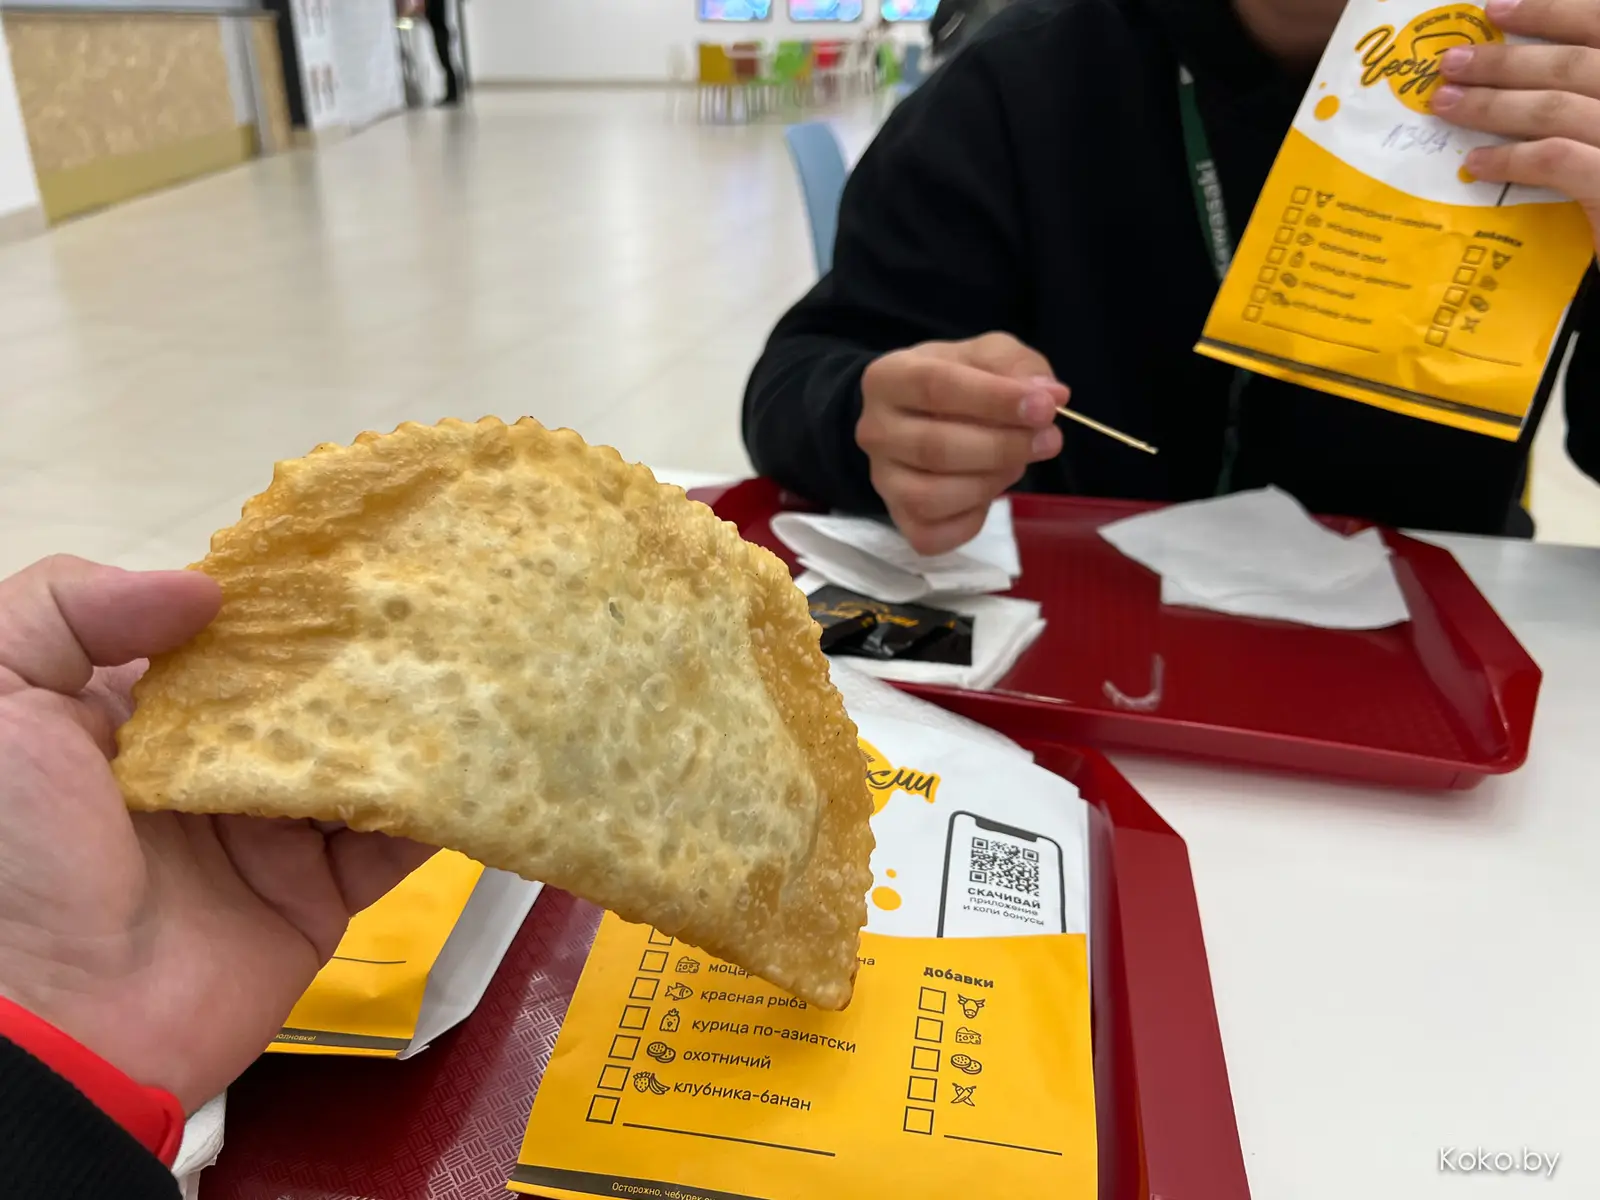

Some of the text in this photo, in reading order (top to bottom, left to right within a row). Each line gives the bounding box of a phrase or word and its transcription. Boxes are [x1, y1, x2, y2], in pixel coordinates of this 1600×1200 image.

[967, 887, 1041, 909] СКАЧИВАЙ
[969, 897, 1038, 916] приложение
[1003, 911, 1045, 926] бонусы
[708, 963, 754, 979] моцар
[923, 966, 994, 989] добавки
[700, 988, 808, 1011] красная рыба
[692, 1019, 857, 1053] курица по-азиатски
[683, 1050, 772, 1070] охотничий
[673, 1081, 812, 1111] клубника-банан
[612, 1182, 663, 1197] Осторожно,
